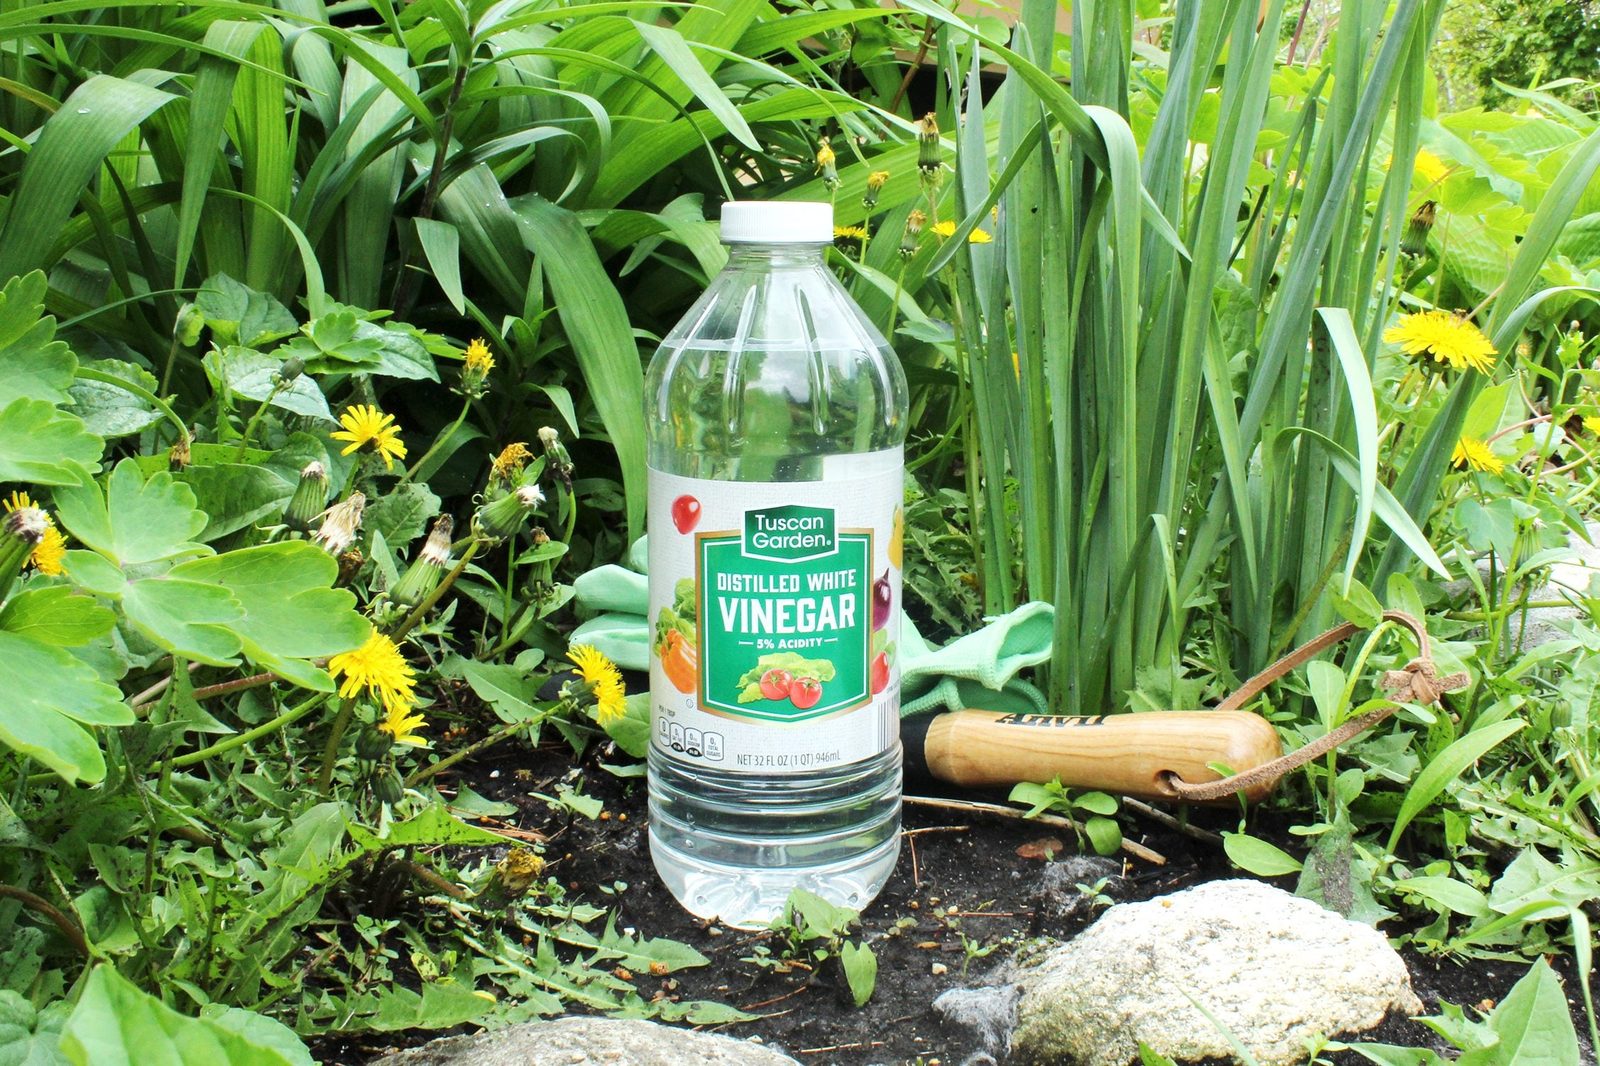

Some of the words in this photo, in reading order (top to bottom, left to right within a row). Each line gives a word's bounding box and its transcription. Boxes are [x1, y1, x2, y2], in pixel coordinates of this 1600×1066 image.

[755, 515, 824, 530] Tuscan
[717, 572, 800, 593] DISTILLED
[807, 569, 857, 592] WHITE
[718, 593, 856, 634] VINEGAR
[756, 638, 775, 649] 5%
[777, 637, 823, 649] ACIDITY
[737, 753, 752, 766] NET
[754, 755, 764, 766] 32
[766, 754, 775, 766] FL
[777, 754, 788, 766] OZ
[790, 754, 798, 767] (1
[800, 752, 814, 767] QT)
[815, 749, 840, 764] 946mL
